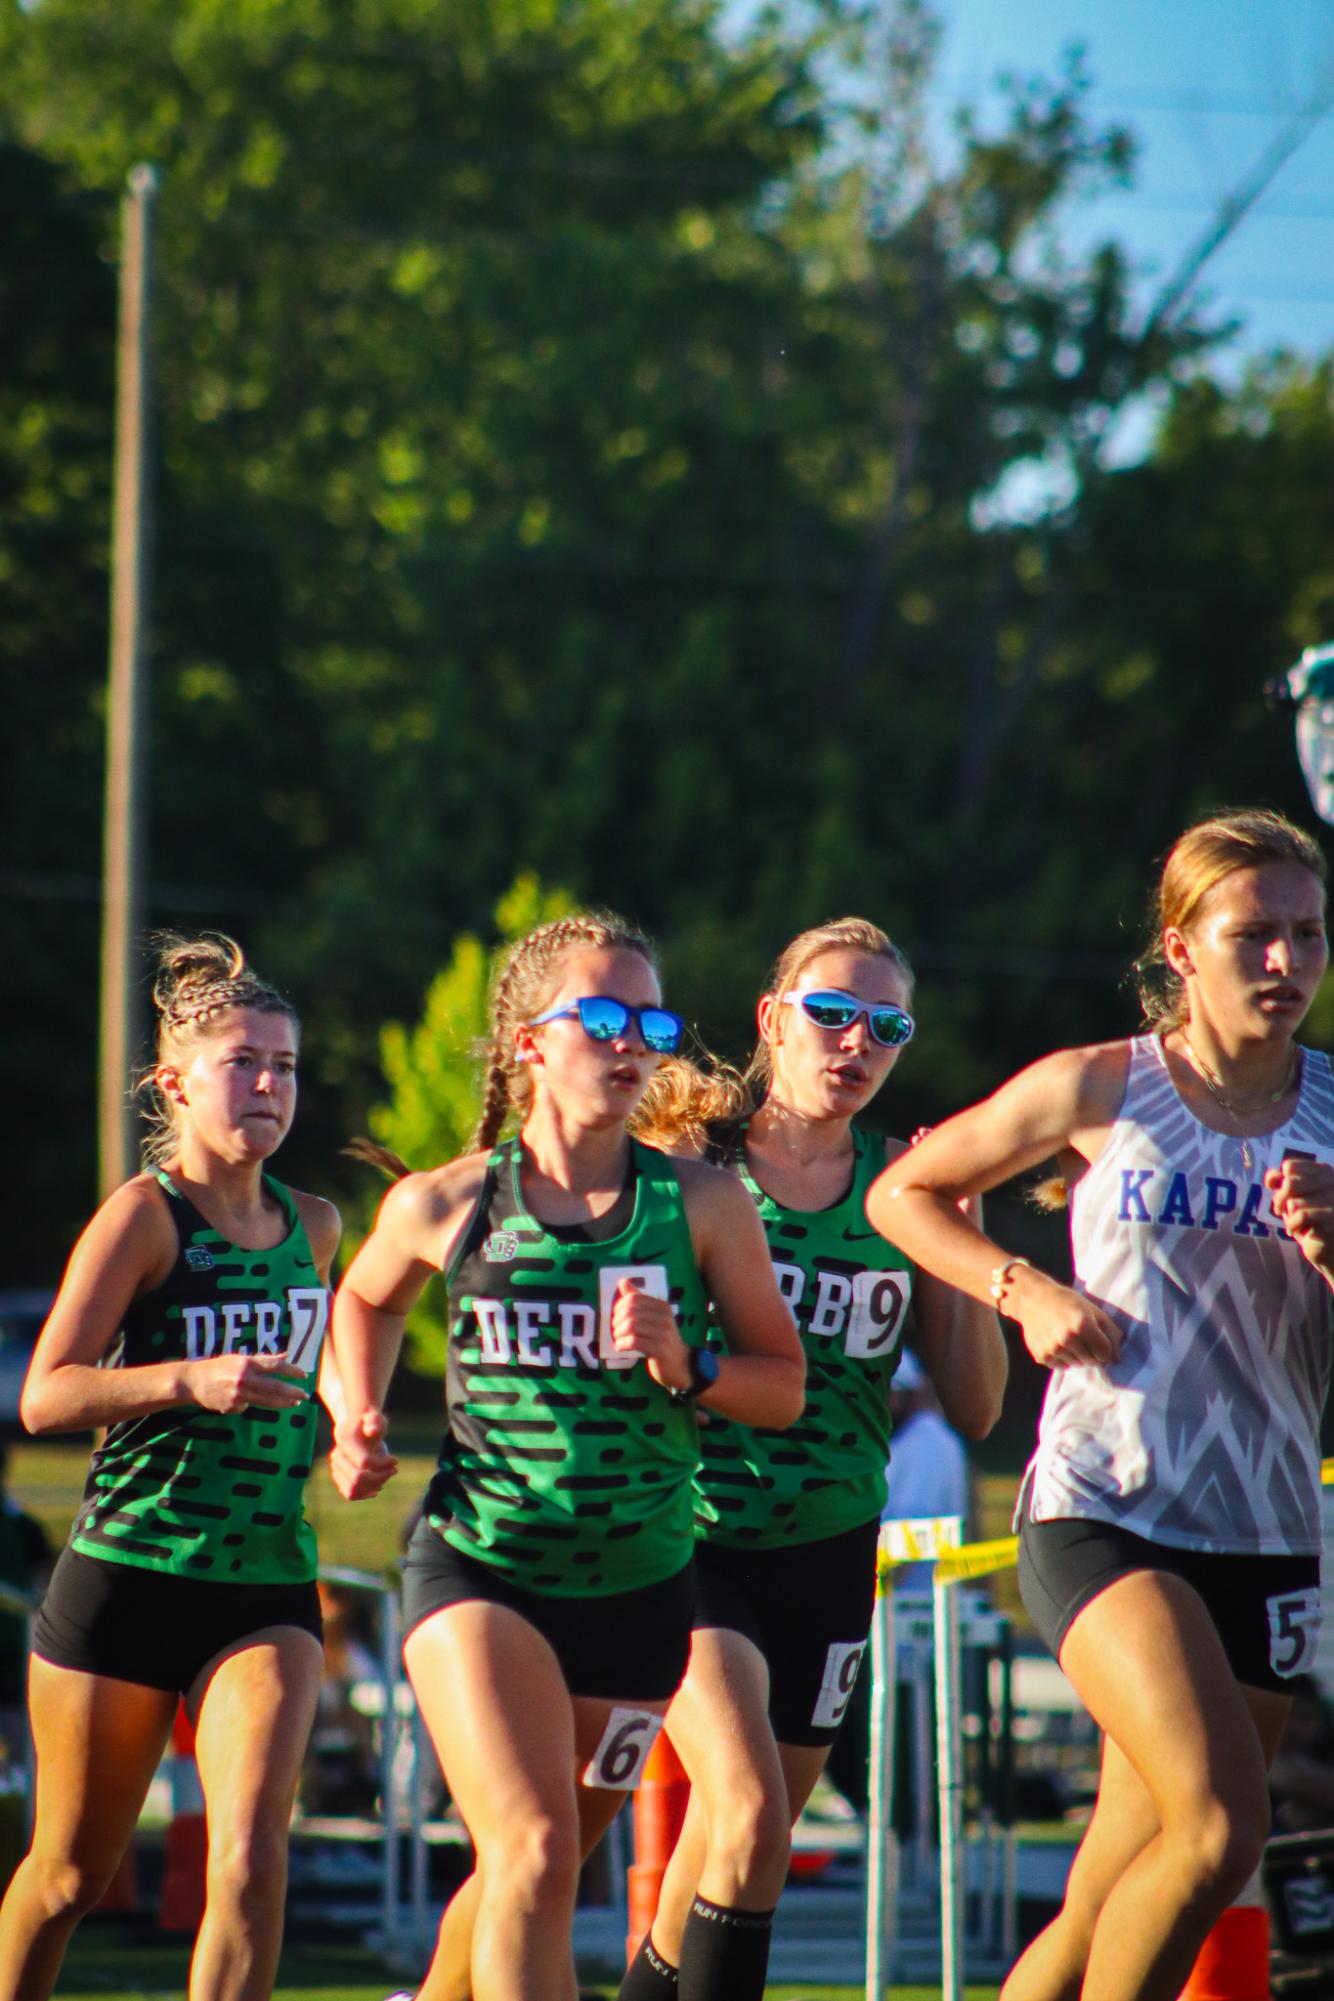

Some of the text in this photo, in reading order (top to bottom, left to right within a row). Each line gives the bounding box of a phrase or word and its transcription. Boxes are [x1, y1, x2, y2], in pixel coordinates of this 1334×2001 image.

[1118, 1169, 1296, 1243] KAPA
[182, 1302, 293, 1361] DER
[296, 1298, 319, 1365] 7
[472, 1300, 679, 1369] DER
[870, 1278, 904, 1350] 9
[1276, 1600, 1306, 1672] 5
[831, 1648, 862, 1719] 9
[600, 1717, 651, 1784] 6
[693, 1902, 718, 1921] RUN
